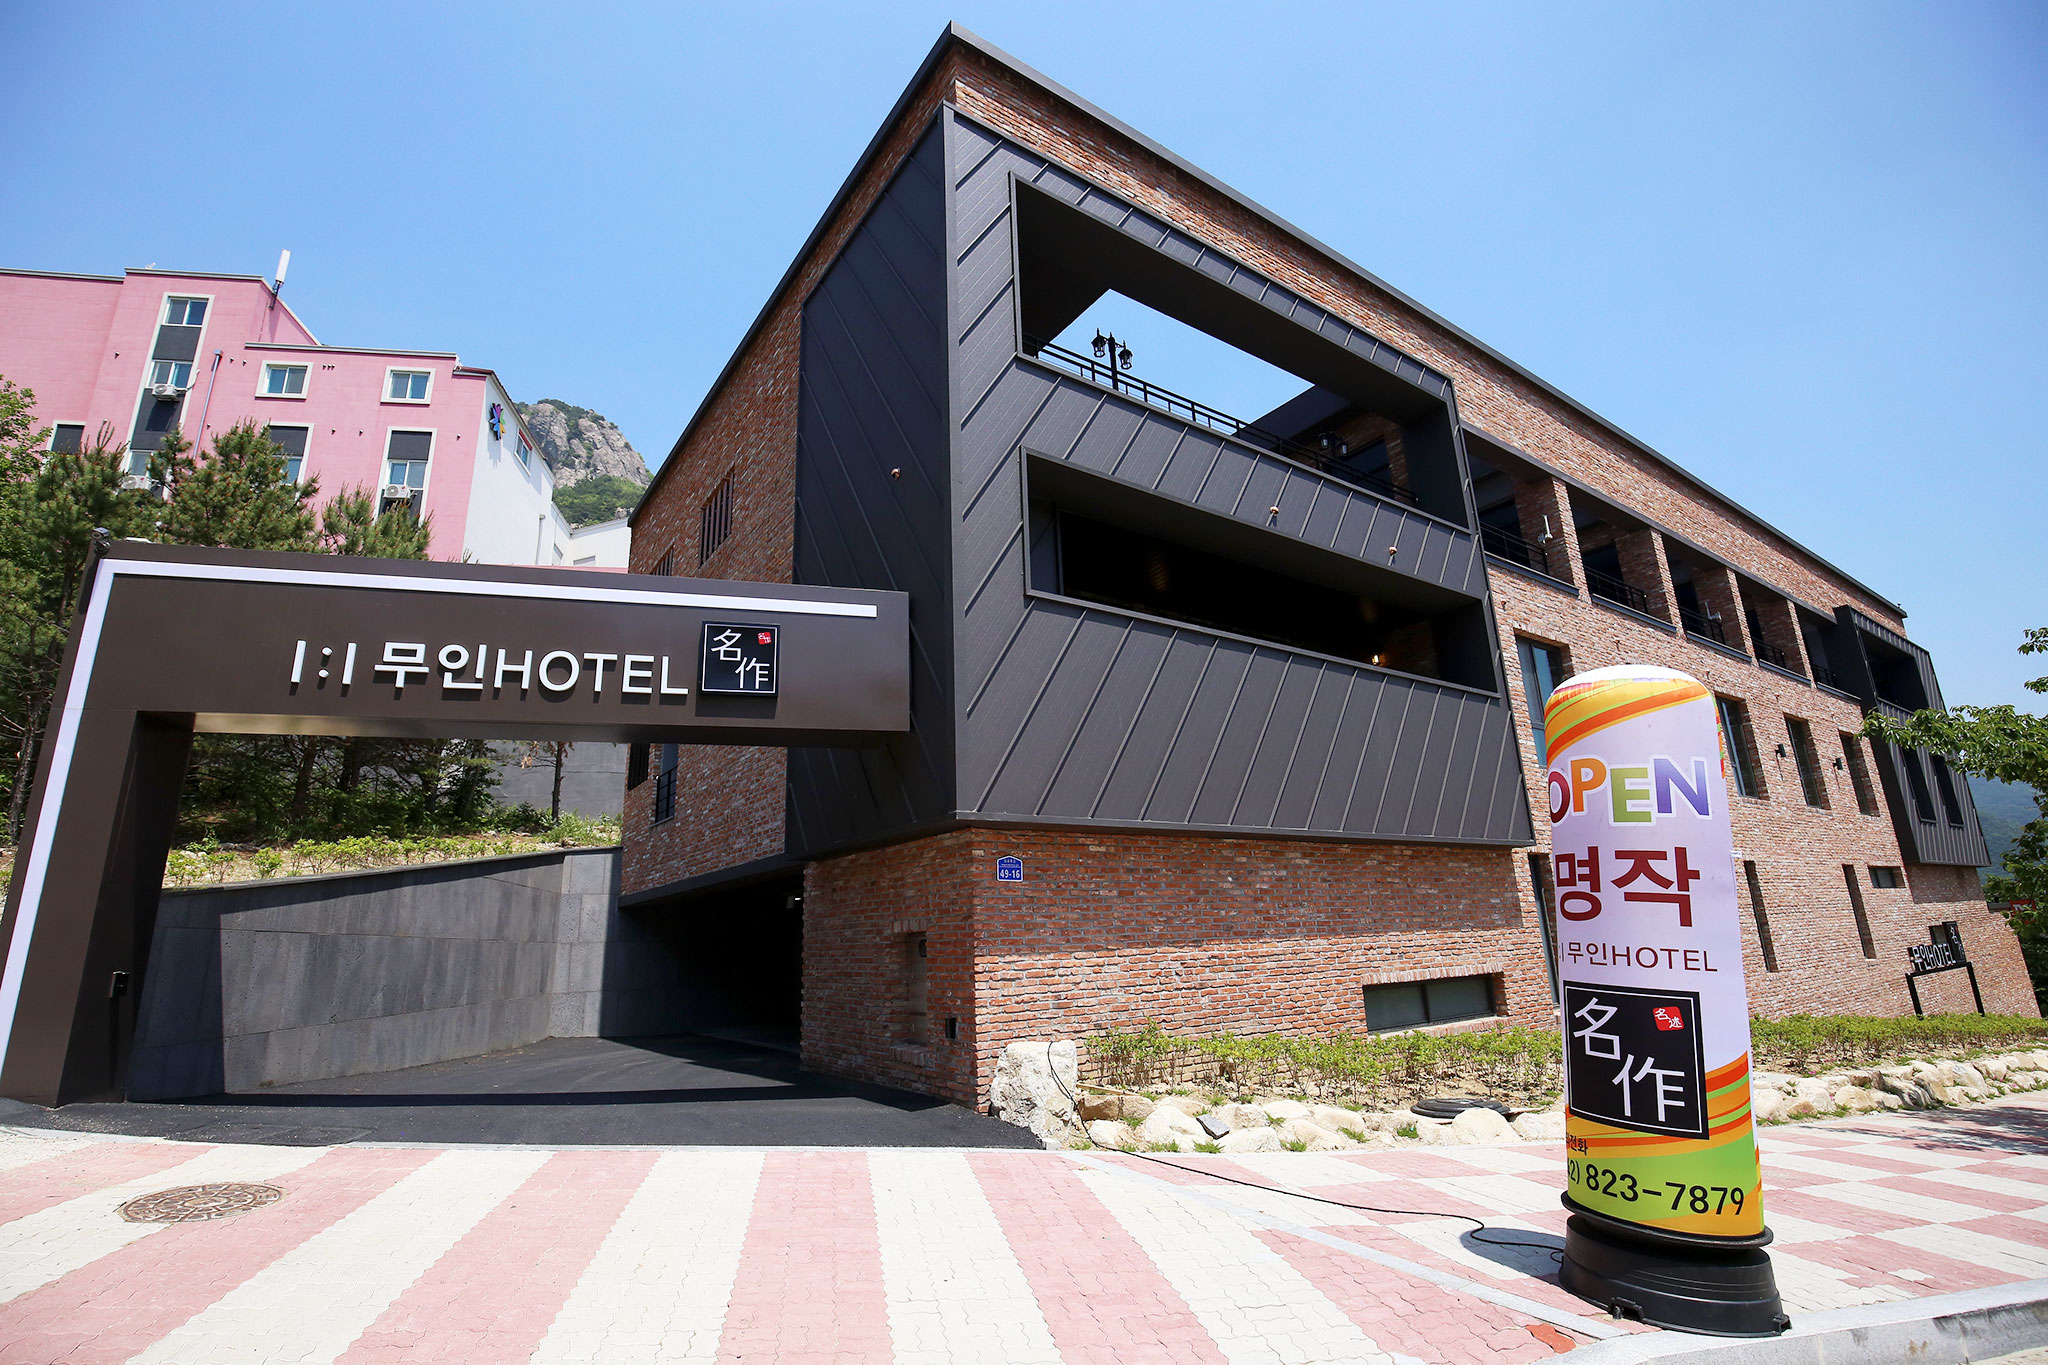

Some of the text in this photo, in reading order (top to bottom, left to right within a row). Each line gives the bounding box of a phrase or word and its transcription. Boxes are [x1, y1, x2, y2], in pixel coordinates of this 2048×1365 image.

[374, 642, 688, 695] 무인HOTEL
[1550, 757, 1710, 824] OPEN
[1000, 869, 1020, 879] 49-16
[1555, 845, 1701, 928] 명작
[1573, 997, 1686, 1122] 名作
[1586, 1163, 1744, 1216] 823-7879
